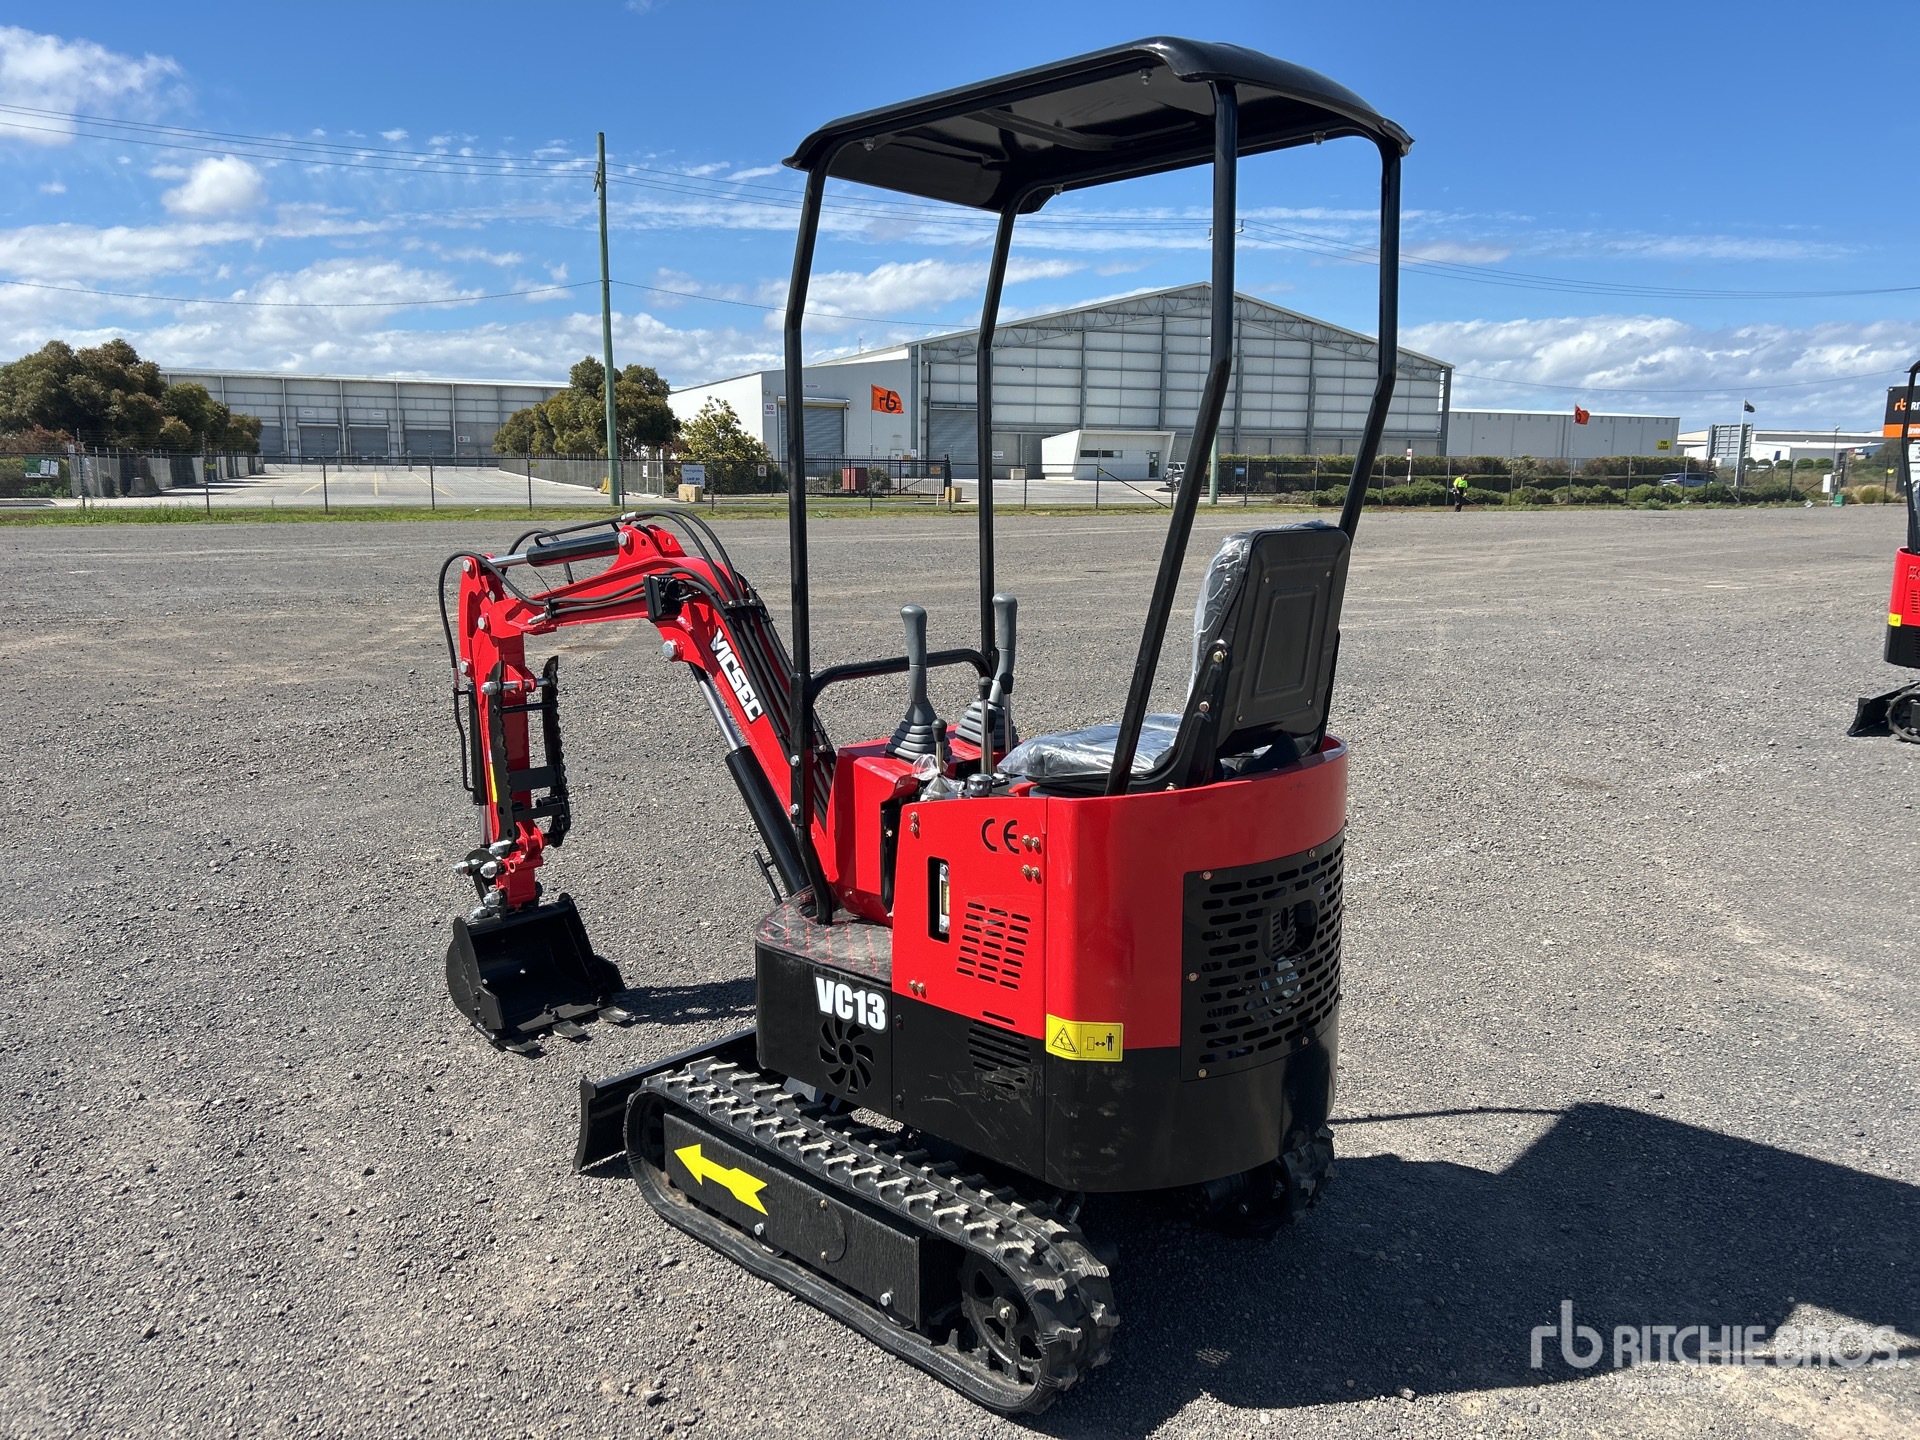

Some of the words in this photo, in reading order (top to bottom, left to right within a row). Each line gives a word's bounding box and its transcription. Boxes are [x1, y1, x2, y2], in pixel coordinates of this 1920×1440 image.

[879, 391, 897, 411] rb
[981, 818, 1020, 854] CE
[815, 976, 887, 1031] VC13
